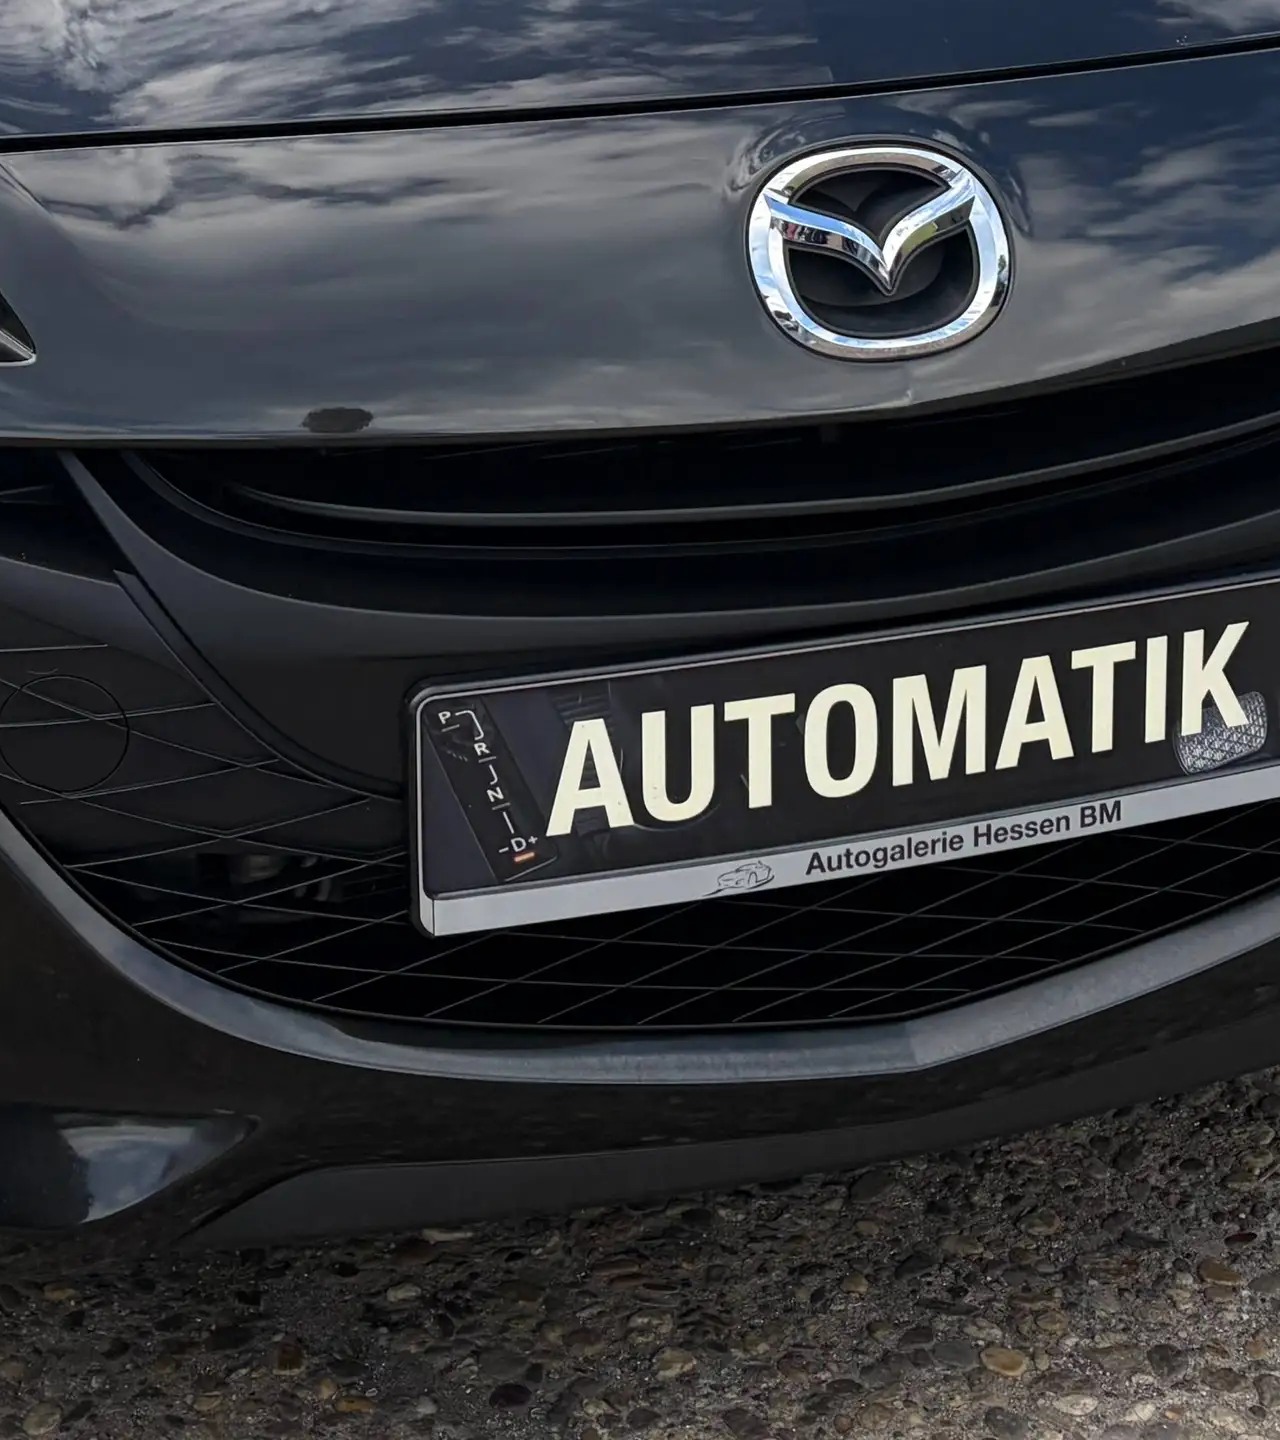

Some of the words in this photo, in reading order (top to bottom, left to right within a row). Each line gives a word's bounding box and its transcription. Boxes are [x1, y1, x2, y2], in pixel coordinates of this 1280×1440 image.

[438, 710, 452, 724] P
[545, 621, 1251, 837] AUTOMATIK
[473, 742, 491, 756] R
[486, 787, 504, 802] N
[805, 831, 965, 876] Autogalerie
[973, 812, 1071, 849] Hessen
[1079, 800, 1122, 829] BM
